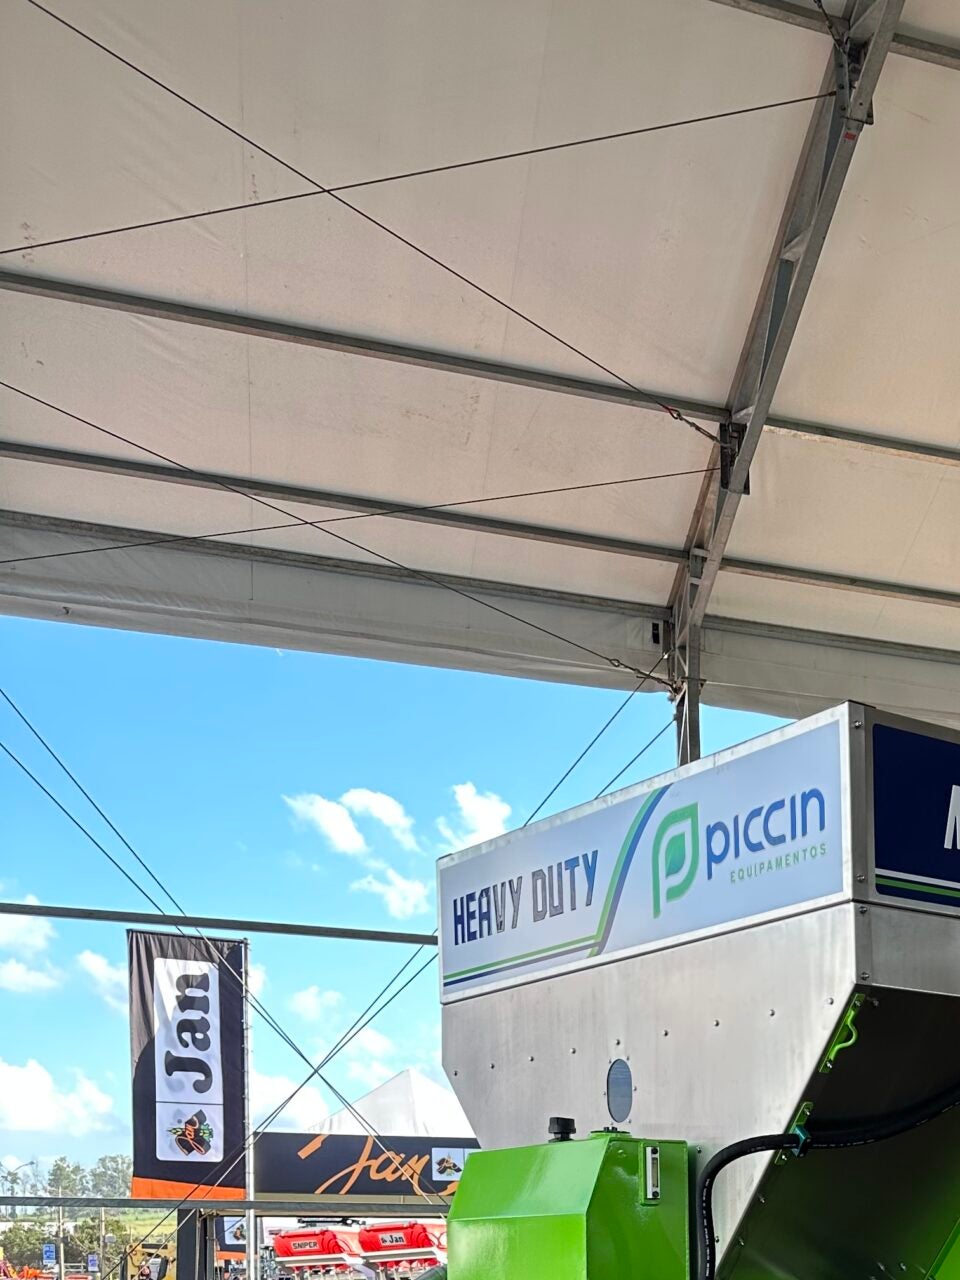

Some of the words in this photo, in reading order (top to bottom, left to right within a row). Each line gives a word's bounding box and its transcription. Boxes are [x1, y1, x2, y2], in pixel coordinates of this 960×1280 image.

[730, 843, 827, 884] EQUIPAMENTOS
[453, 876, 522, 945] HEAVY
[531, 850, 598, 923] DUTY
[165, 972, 213, 1094] Jan
[292, 1241, 318, 1250] SNIPER
[389, 1234, 404, 1244] Jan
